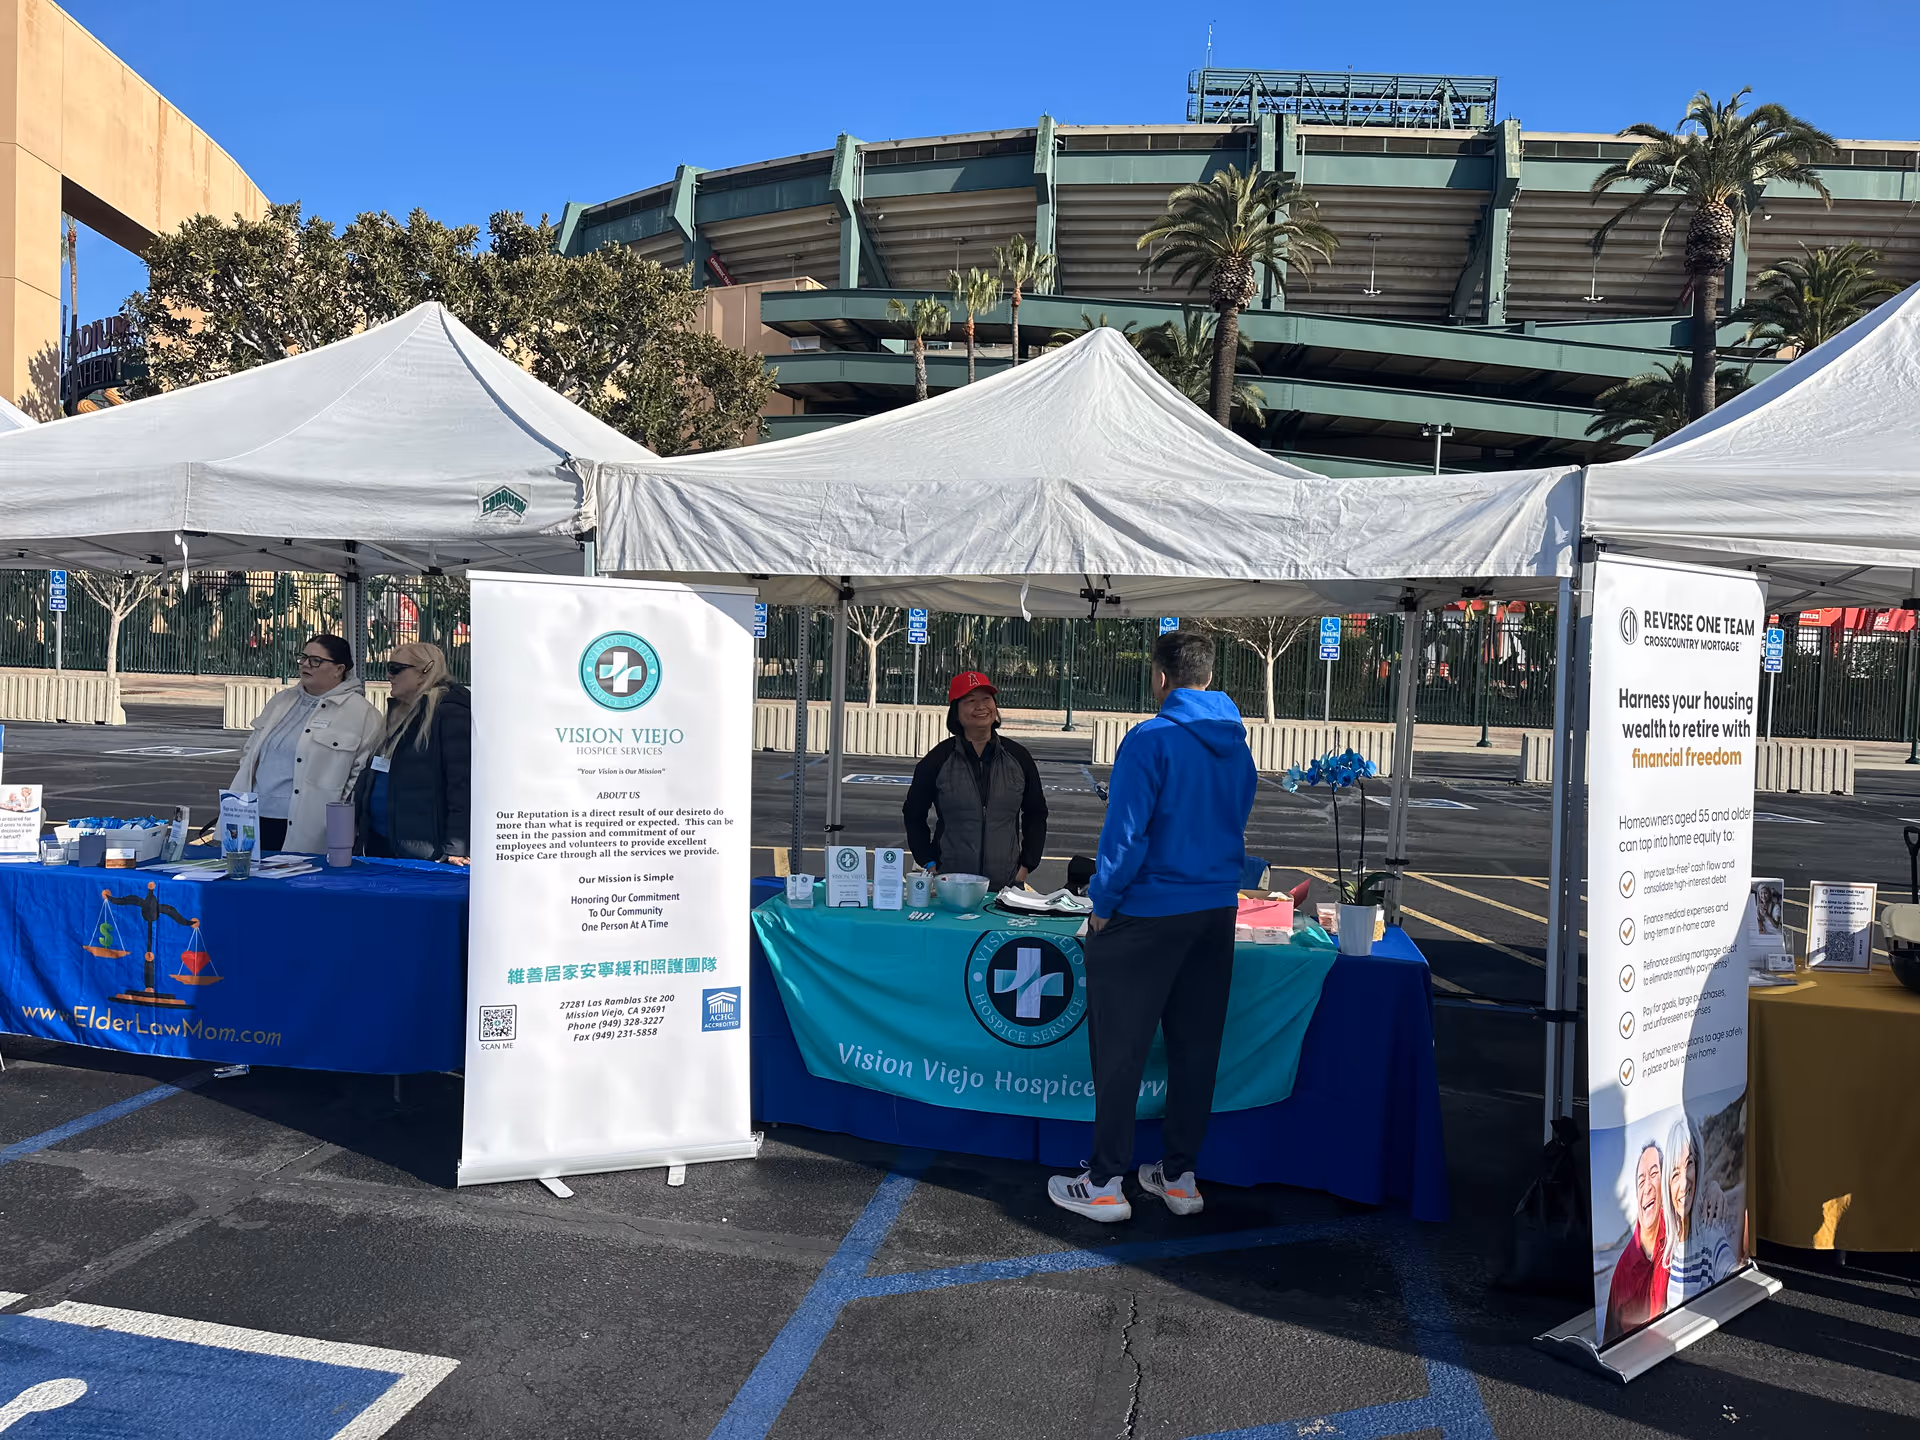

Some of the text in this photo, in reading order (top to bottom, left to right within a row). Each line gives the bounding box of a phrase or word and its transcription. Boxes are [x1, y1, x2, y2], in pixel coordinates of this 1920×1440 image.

[482, 489, 526, 514] CARAVAN
[1644, 610, 1754, 636] REVERSE ONE TEAM
[1644, 635, 1740, 651] CROSSCOUNTRY MORTGAGE
[968, 673, 980, 686] A
[1619, 688, 1753, 715] Harness your housing
[555, 728, 684, 745] VISION VIEJO
[1622, 719, 1750, 738] wealth to retire with
[1632, 747, 1742, 768] financial freedom
[496, 811, 514, 819] Our
[517, 810, 568, 820] Reputation
[585, 819, 623, 829] required
[638, 818, 680, 828] expected.
[1619, 807, 1751, 830] Homeowners aged 55 and older
[552, 830, 586, 840] passion
[589, 829, 606, 837] and
[609, 829, 666, 837] commitment
[1619, 829, 1734, 852] can tap into home equity to:
[496, 842, 546, 852] employees
[569, 840, 617, 848] volunteers
[631, 838, 664, 848] provide
[496, 852, 534, 862] Hospice
[560, 850, 597, 860] through
[631, 848, 666, 856] services
[684, 847, 719, 857] provide.
[598, 875, 631, 883] Mission
[644, 873, 674, 882] Simple
[1644, 859, 1735, 880] Improve cash flow and
[1644, 874, 1726, 894] consolidate high-interest debt
[571, 893, 680, 905] Honoring Our Commitment
[589, 906, 663, 917] To Our Community
[1644, 902, 1728, 925] Finance medical expenses and
[582, 923, 598, 931] One
[601, 922, 628, 930] Person
[630, 920, 639, 929] At
[648, 920, 668, 928] Time
[1644, 919, 1715, 941] long-term in-home care
[1643, 944, 1737, 971] Refinance existing mortgage debt
[508, 957, 718, 985] 維善居家安寧緩和照護團隊
[1674, 964, 1695, 976] monthly
[560, 1000, 585, 1009] 27281
[605, 996, 641, 1006] Ramblas
[1643, 995, 1692, 1017] Pay large
[566, 1010, 598, 1019] Mission
[602, 1008, 624, 1018] Viejo,
[641, 1006, 666, 1014] 92691
[976, 994, 1084, 1042] HOSPICE SERVICE
[1684, 1006, 1712, 1019] expenses
[21, 1005, 281, 1046] wwElderLawMom.com
[568, 1016, 664, 1031] Phone (949) 328-3227
[574, 1028, 657, 1042] Fax (949) 231-5858
[1656, 1032, 1725, 1057] home age
[1698, 1047, 1716, 1058] home
[838, 1042, 913, 1078] Vision
[922, 1058, 984, 1095] Viejo
[994, 1069, 1096, 1104] Hospice
